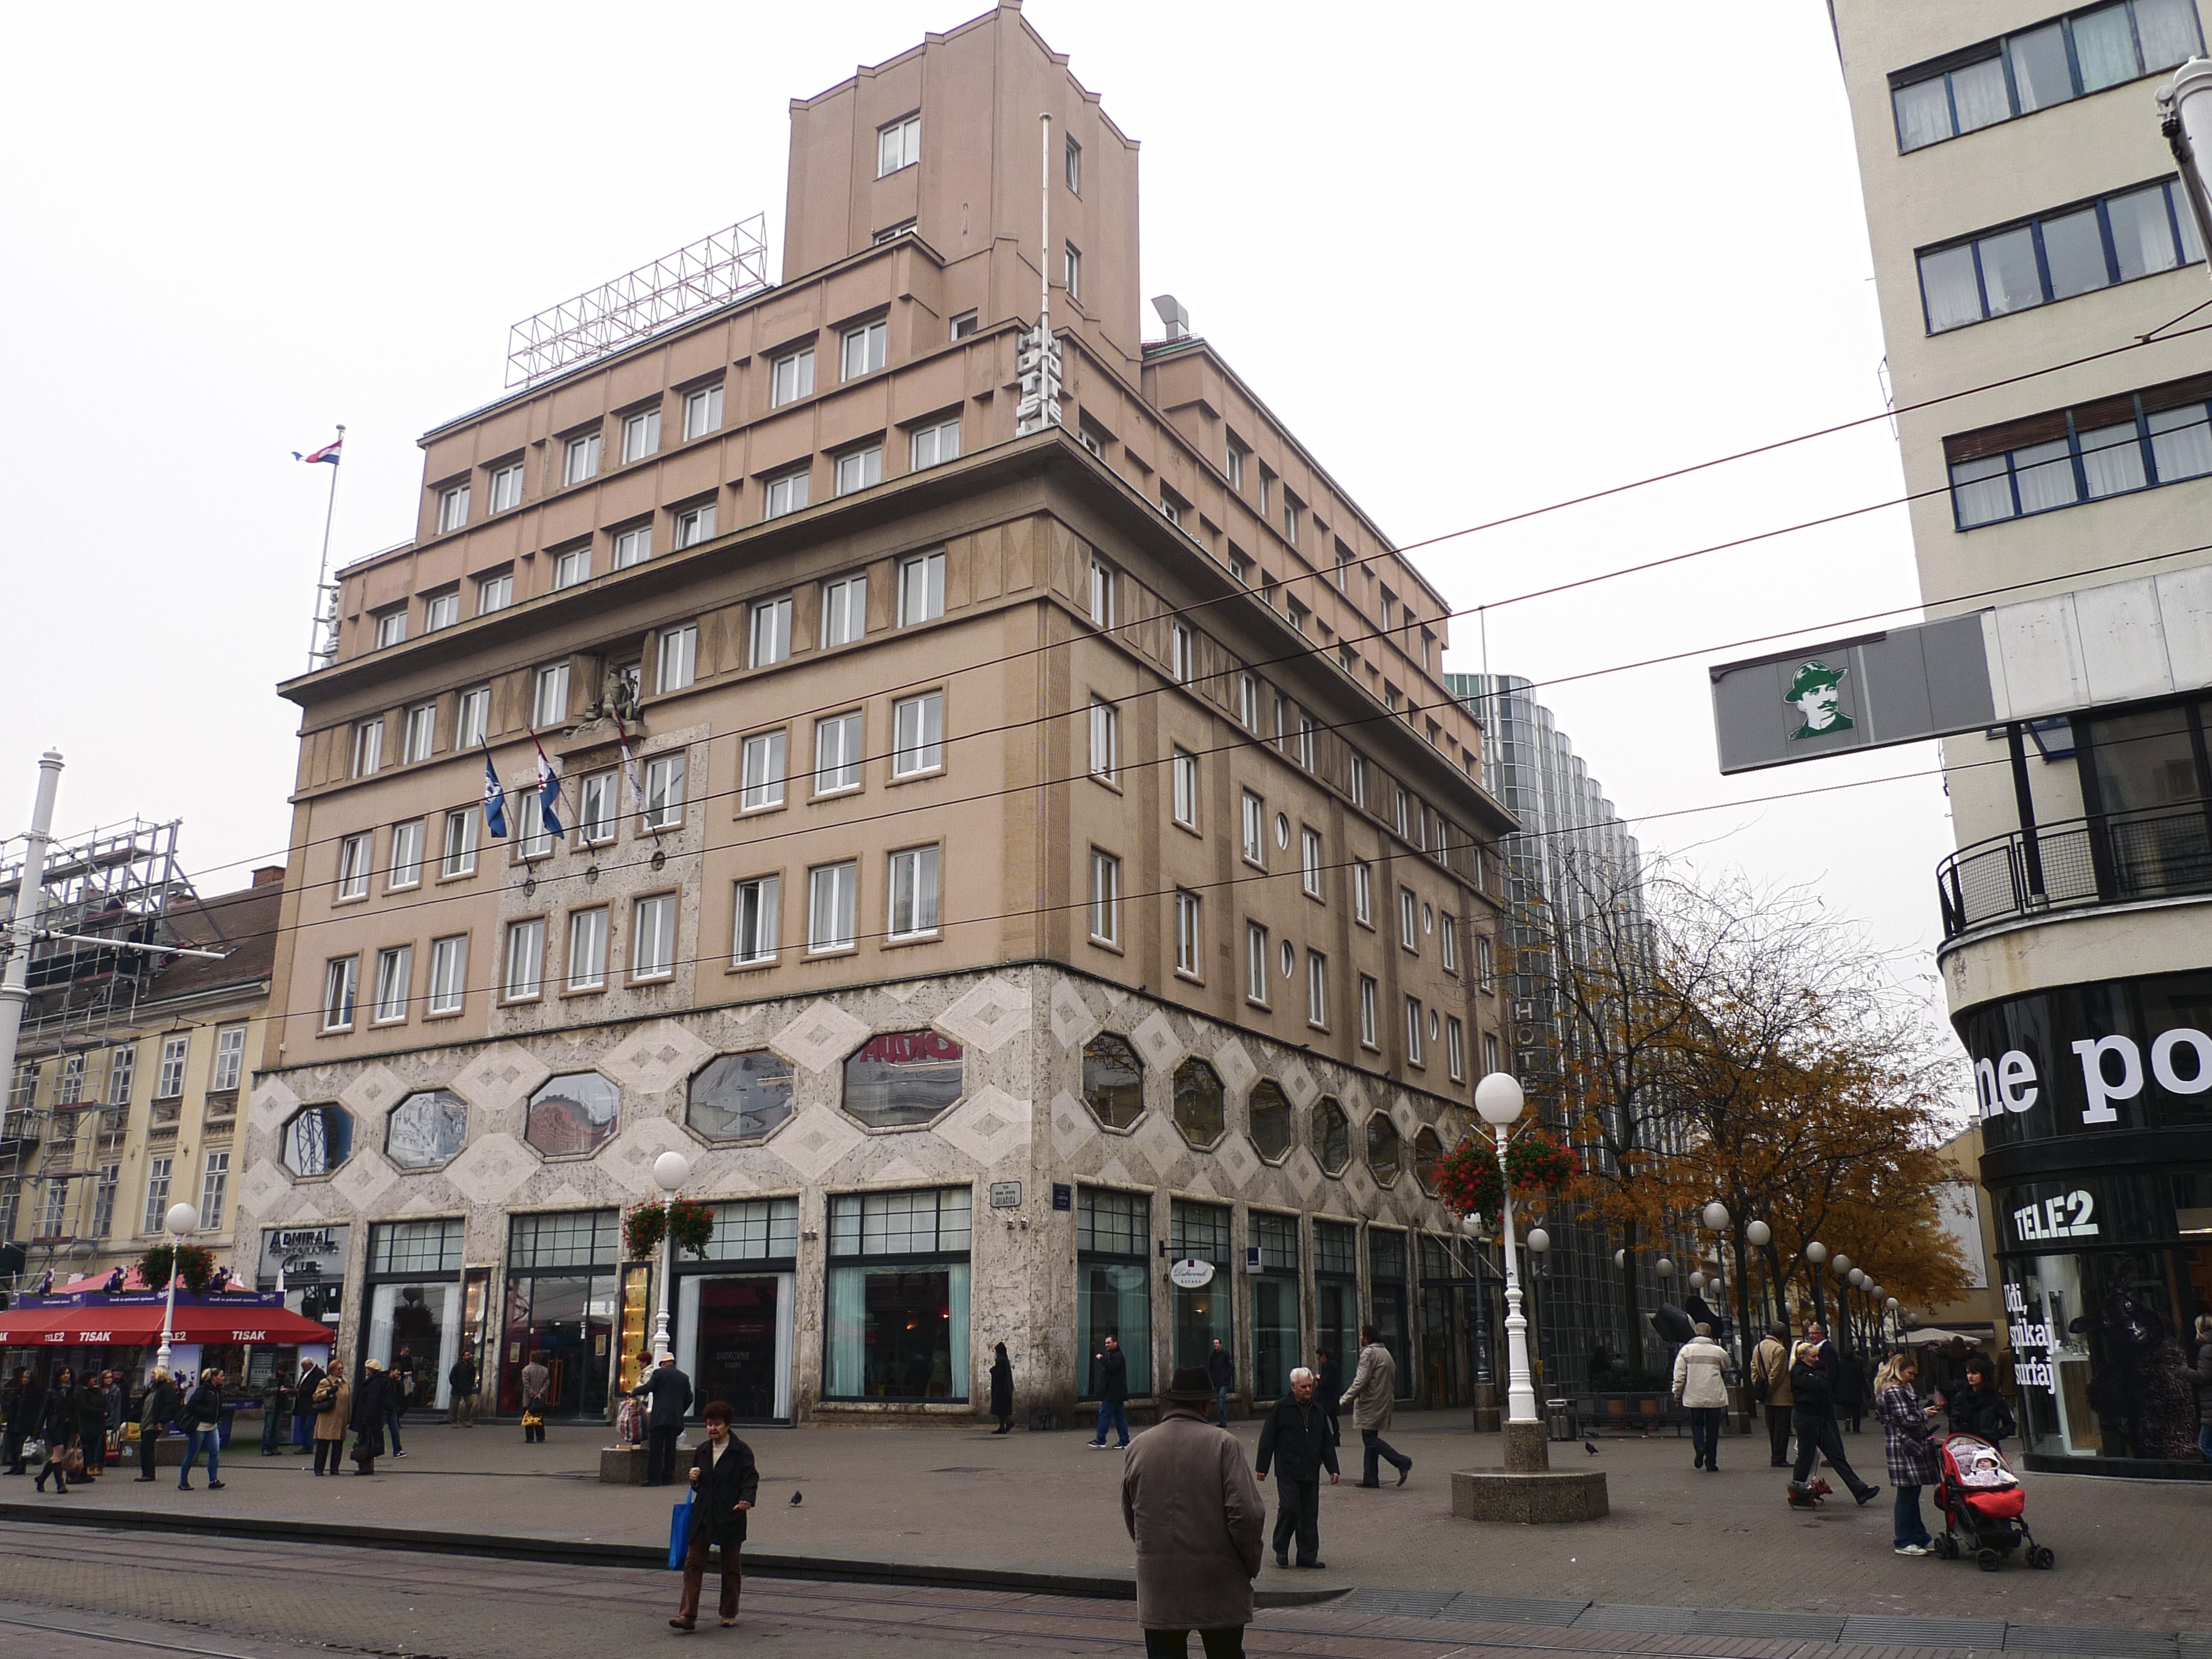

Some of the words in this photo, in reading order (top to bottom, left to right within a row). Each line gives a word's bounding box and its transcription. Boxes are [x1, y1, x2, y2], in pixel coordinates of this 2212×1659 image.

[1515, 1002, 1538, 1094] HOTE
[2014, 1190, 2099, 1241] TELE2
[269, 1228, 335, 1248] ADMIRAL
[2003, 1283, 2028, 1315] Uđi,
[45, 1332, 65, 1342] TELE2
[79, 1332, 112, 1342] TISAK
[232, 1330, 266, 1341] TISAK
[2009, 1317, 2060, 1355] spikaj,
[2014, 1356, 2055, 1395] surfaj
